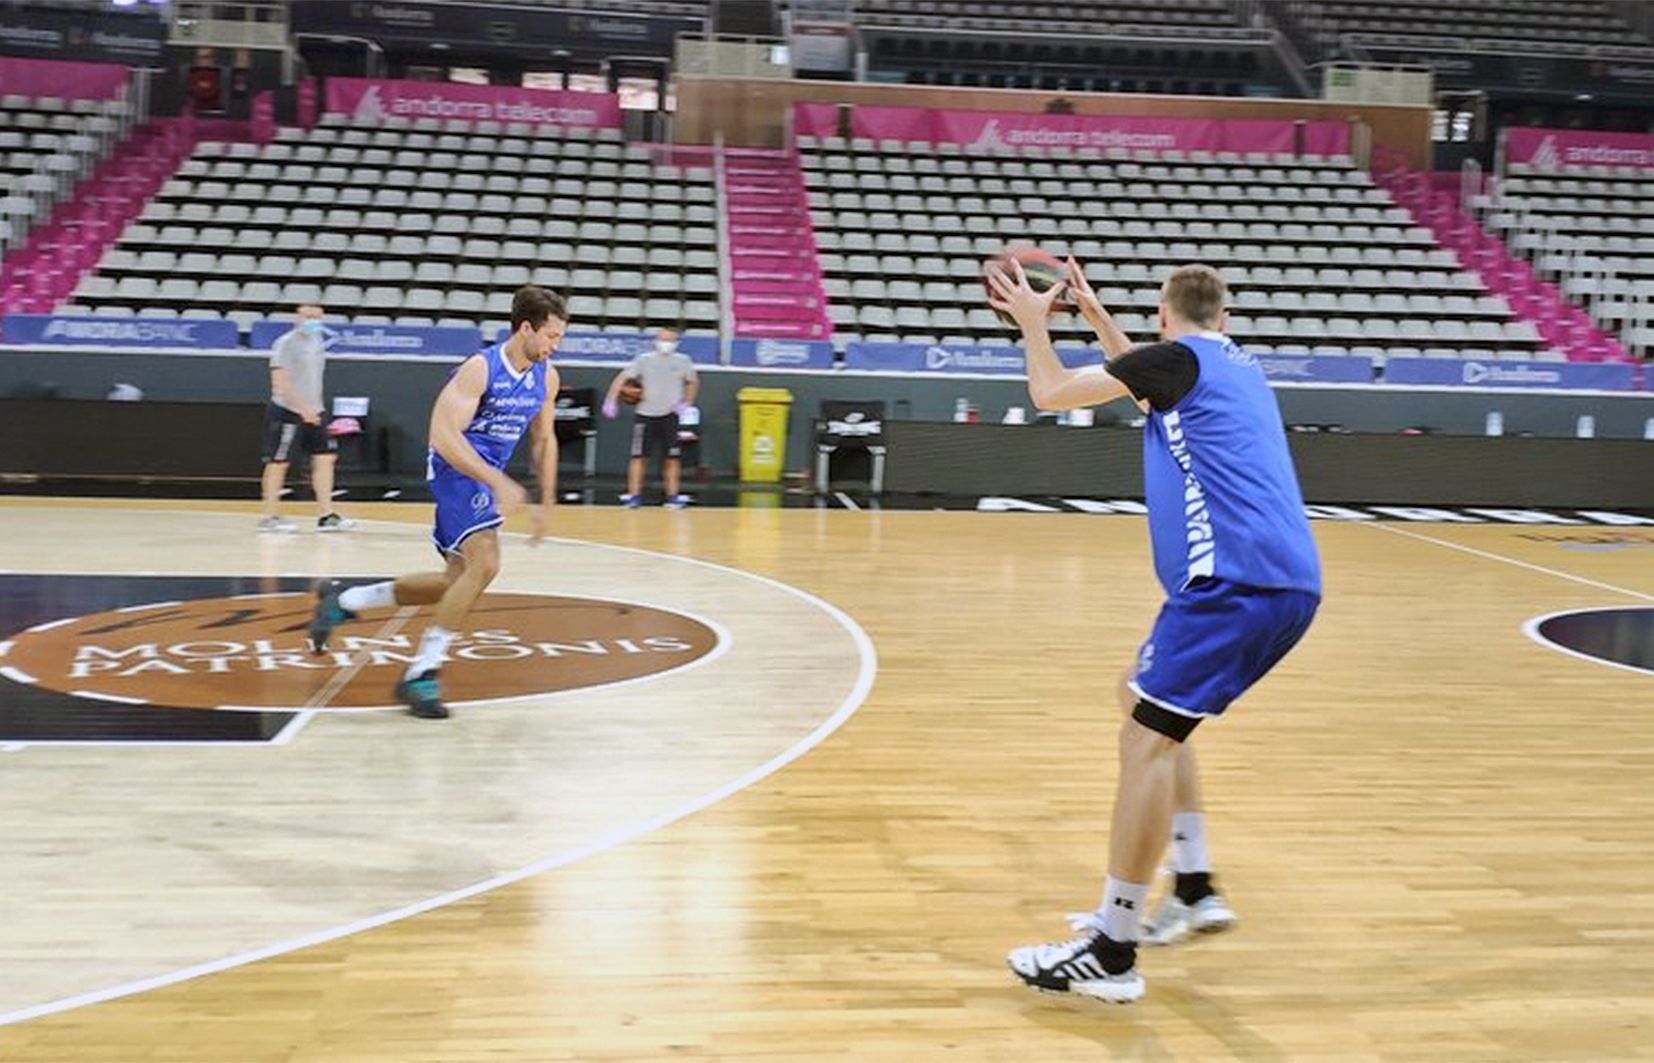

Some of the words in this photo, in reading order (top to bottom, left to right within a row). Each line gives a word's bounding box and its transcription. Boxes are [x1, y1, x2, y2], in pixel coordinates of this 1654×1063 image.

[392, 97, 492, 118] andorra
[496, 99, 598, 123] telecom
[66, 636, 694, 679] PATRIMONIS
